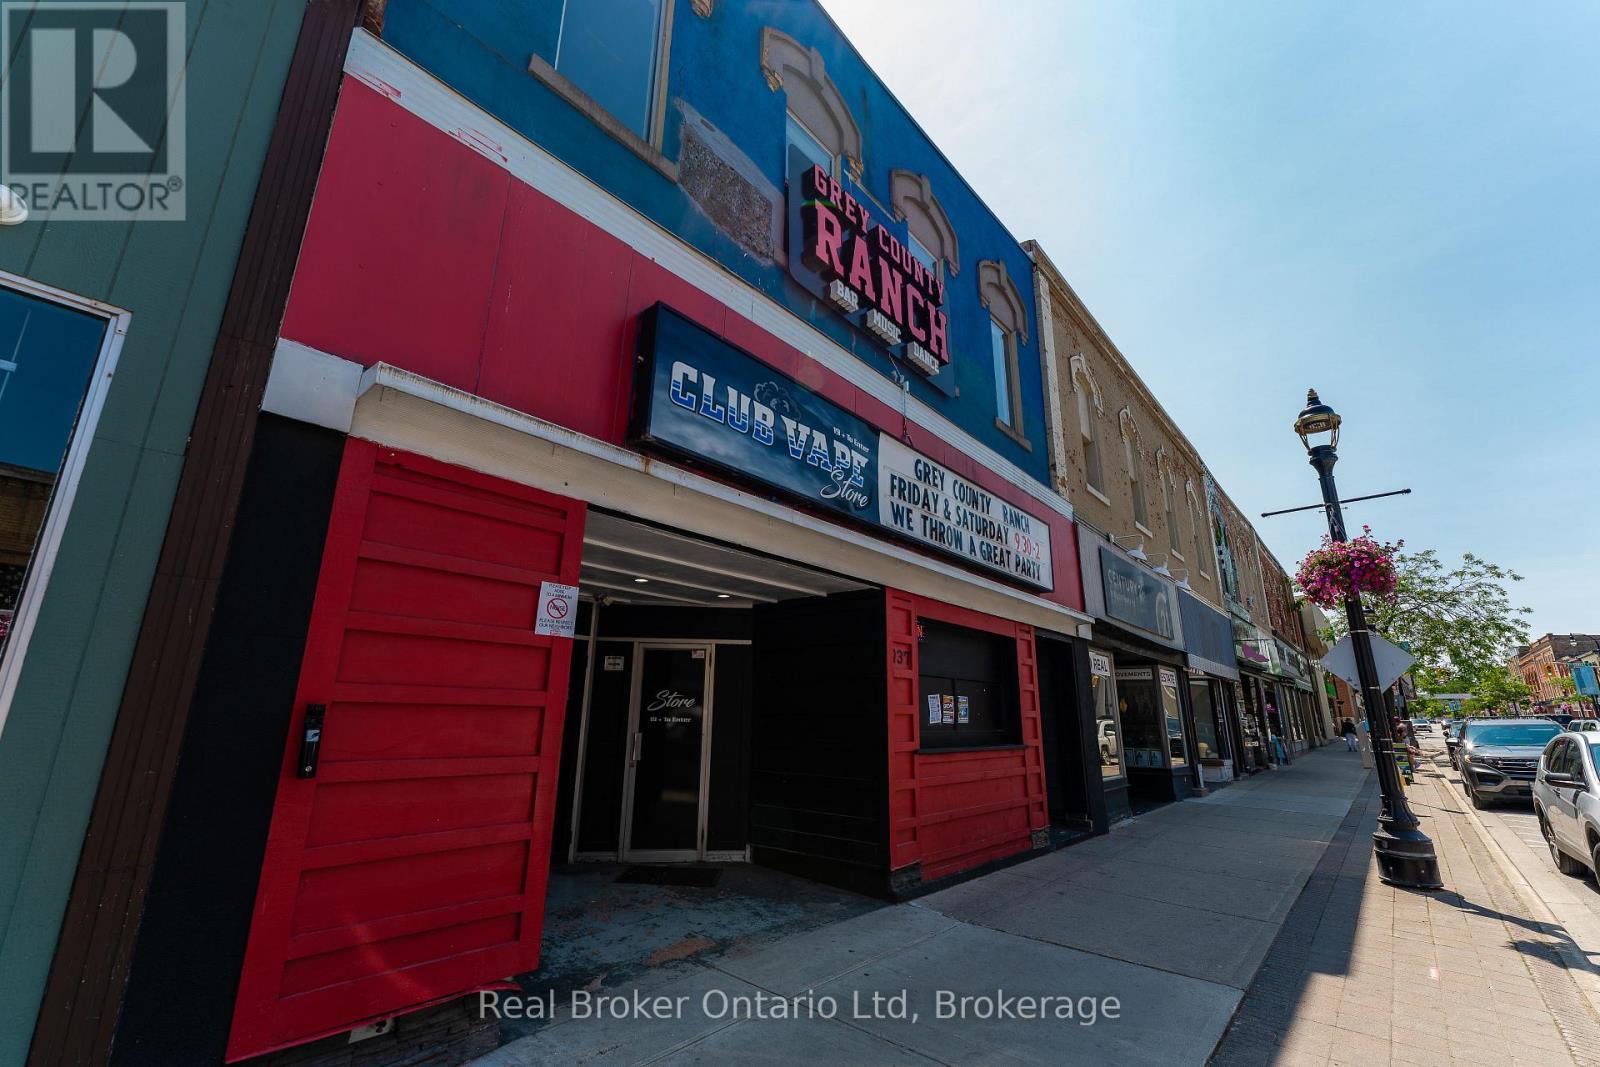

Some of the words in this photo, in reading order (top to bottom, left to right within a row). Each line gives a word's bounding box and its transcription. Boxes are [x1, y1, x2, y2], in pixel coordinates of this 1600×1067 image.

[814, 163, 870, 233] GREY
[877, 224, 944, 304] COUNTY
[815, 199, 949, 363] RANCH
[836, 279, 859, 310] BAR
[873, 308, 902, 343] MUSIC
[913, 341, 939, 374] DANCE
[670, 361, 775, 446] CLUB
[781, 415, 869, 487] VAPE
[854, 438, 869, 453] Enter
[820, 465, 869, 507] Store
[914, 458, 945, 492] GREY
[953, 479, 991, 515] COUNTY
[1002, 504, 1030, 535] RANCH
[890, 473, 939, 514] FRIDAY
[944, 498, 951, 521] &
[956, 506, 1009, 545] SATURDAY
[890, 501, 913, 531] WE
[921, 515, 963, 551] THROW
[969, 536, 977, 556] A
[979, 541, 1011, 569] GREAT
[1015, 555, 1041, 581] PARTY
[1093, 658, 1108, 673] REAL
[1161, 672, 1175, 684] ESTATE
[647, 690, 696, 711] Store
